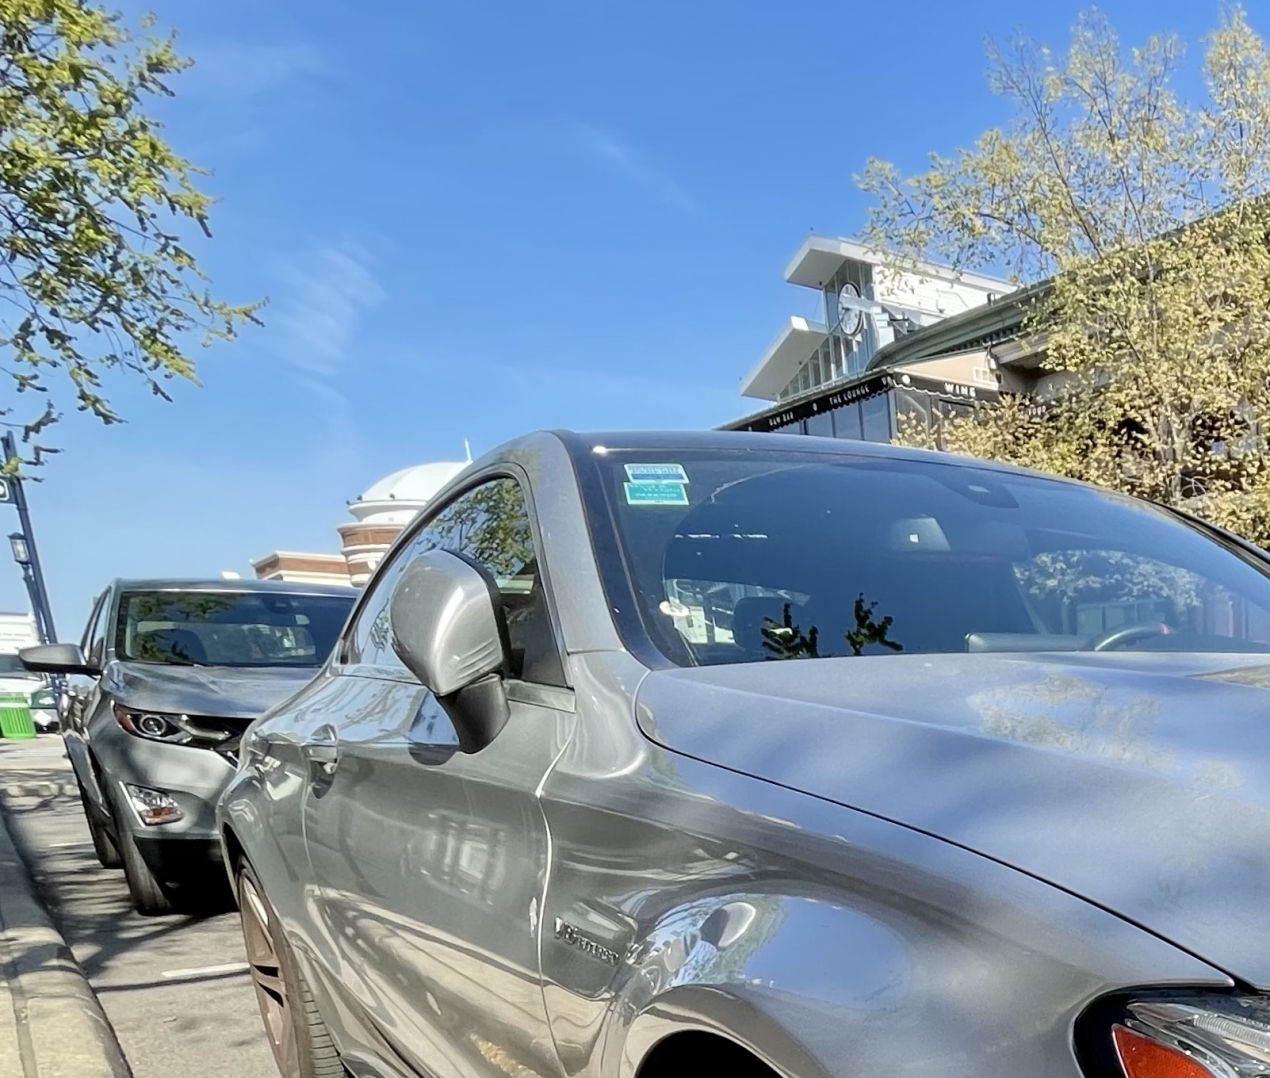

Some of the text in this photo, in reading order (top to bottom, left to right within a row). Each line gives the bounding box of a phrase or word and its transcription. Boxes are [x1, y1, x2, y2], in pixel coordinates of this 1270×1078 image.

[829, 384, 870, 406] THE LOUNGE
[944, 382, 976, 398] WINE
